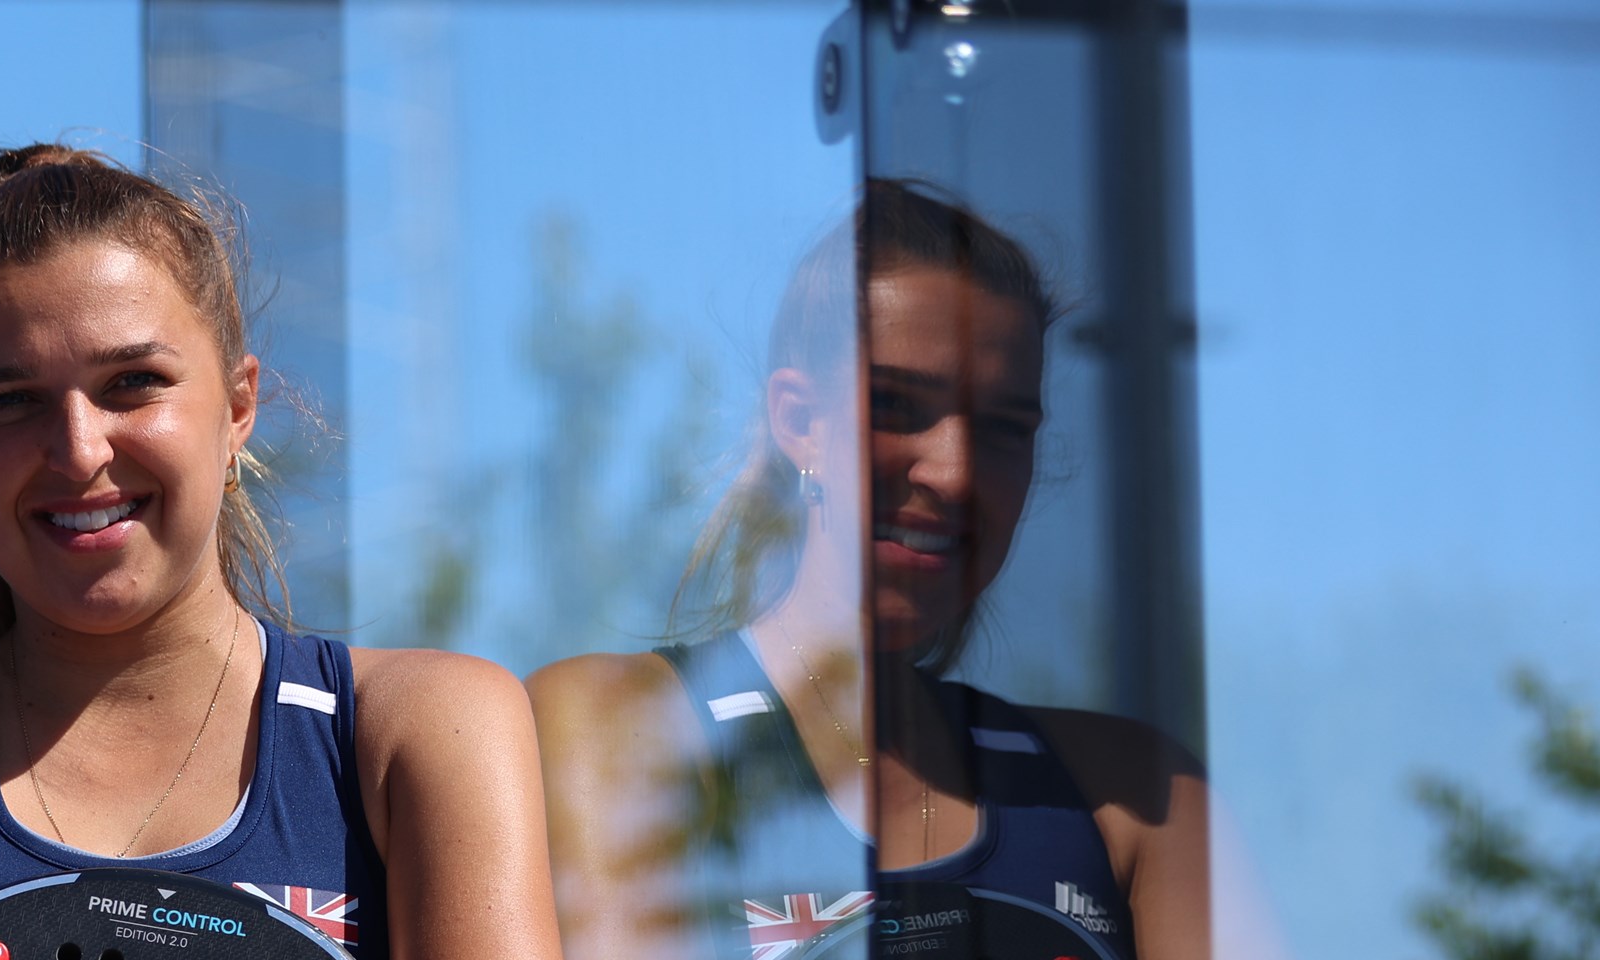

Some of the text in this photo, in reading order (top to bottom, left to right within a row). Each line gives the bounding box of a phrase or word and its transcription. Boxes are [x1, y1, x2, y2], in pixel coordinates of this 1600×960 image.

[88, 896, 247, 937] PRIME CONTROL
[115, 926, 188, 948] EDITION 2.0
